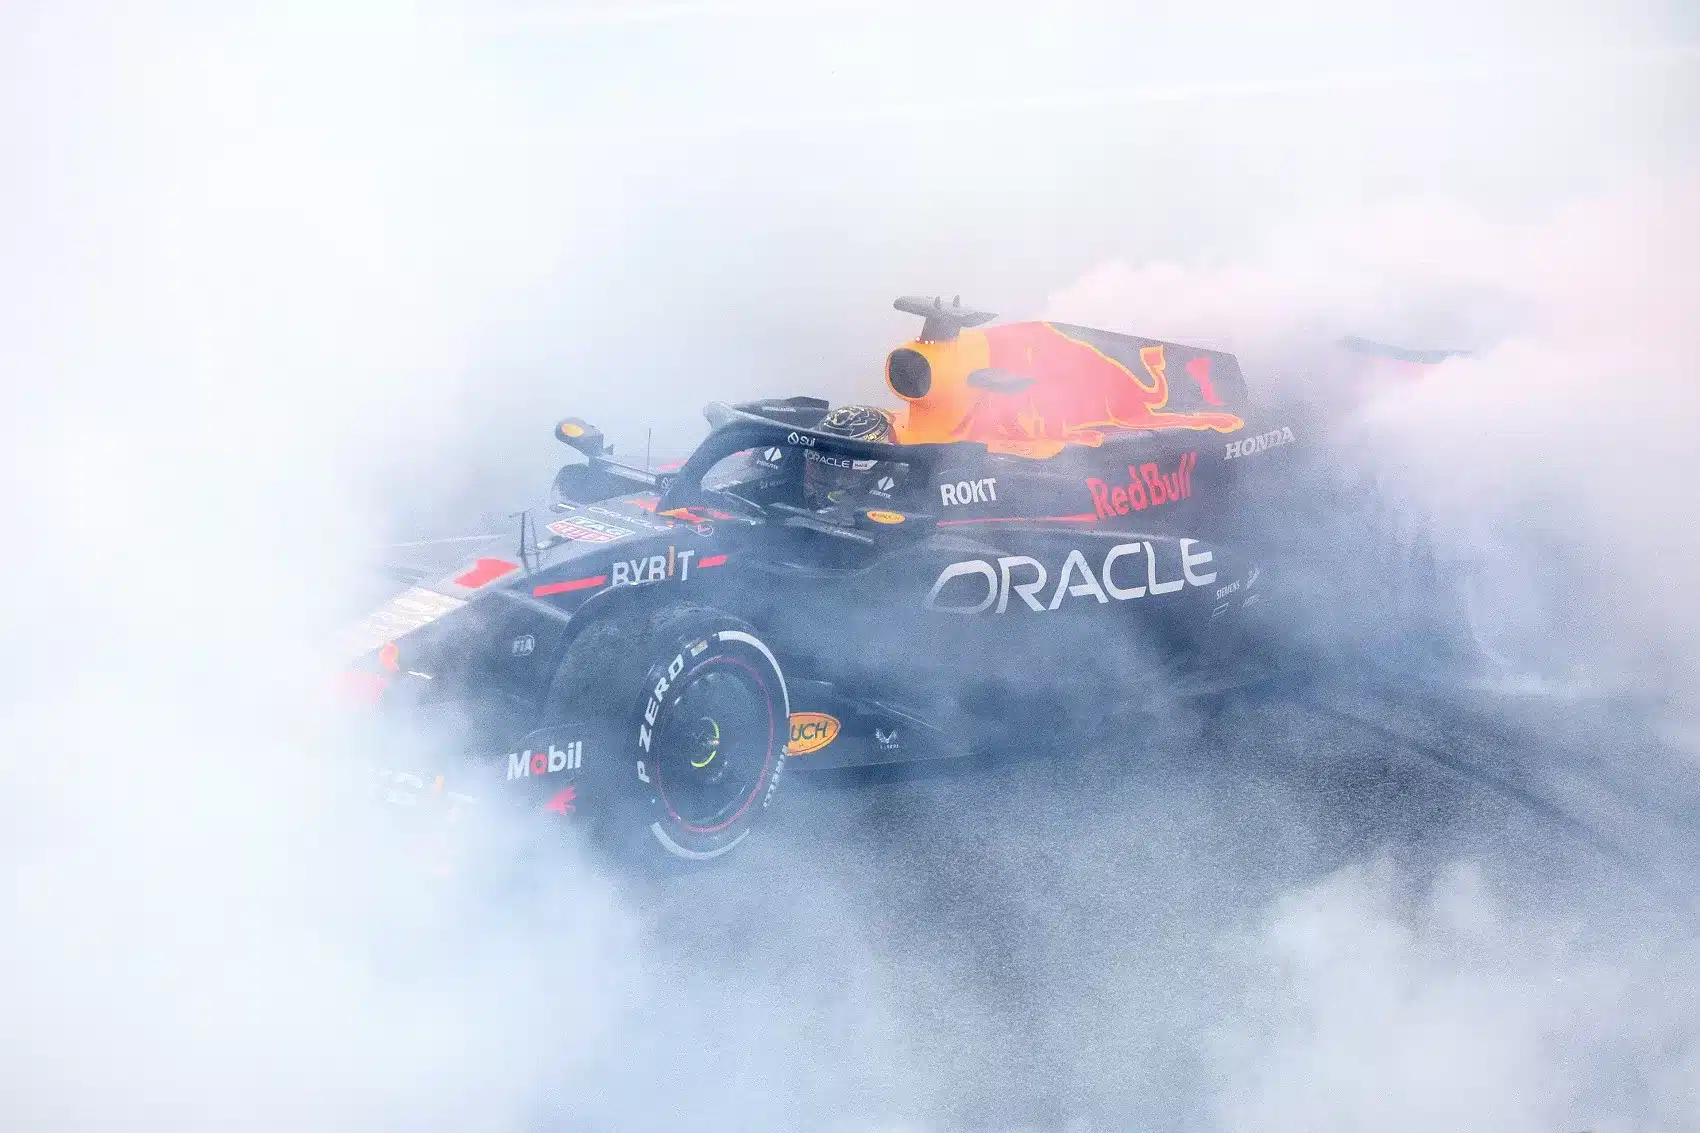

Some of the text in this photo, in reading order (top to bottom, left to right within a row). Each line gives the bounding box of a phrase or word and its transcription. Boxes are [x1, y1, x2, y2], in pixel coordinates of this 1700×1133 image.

[800, 436, 815, 446] Sui
[1224, 427, 1296, 460] HONDA
[807, 451, 850, 468] ORACLE
[940, 478, 997, 506] ROKT
[613, 545, 695, 586] BYBIT
[926, 538, 1217, 614] ORACLE
[637, 654, 684, 783] P ZERO
[791, 721, 829, 742] UCH
[507, 741, 582, 780] Mobil
